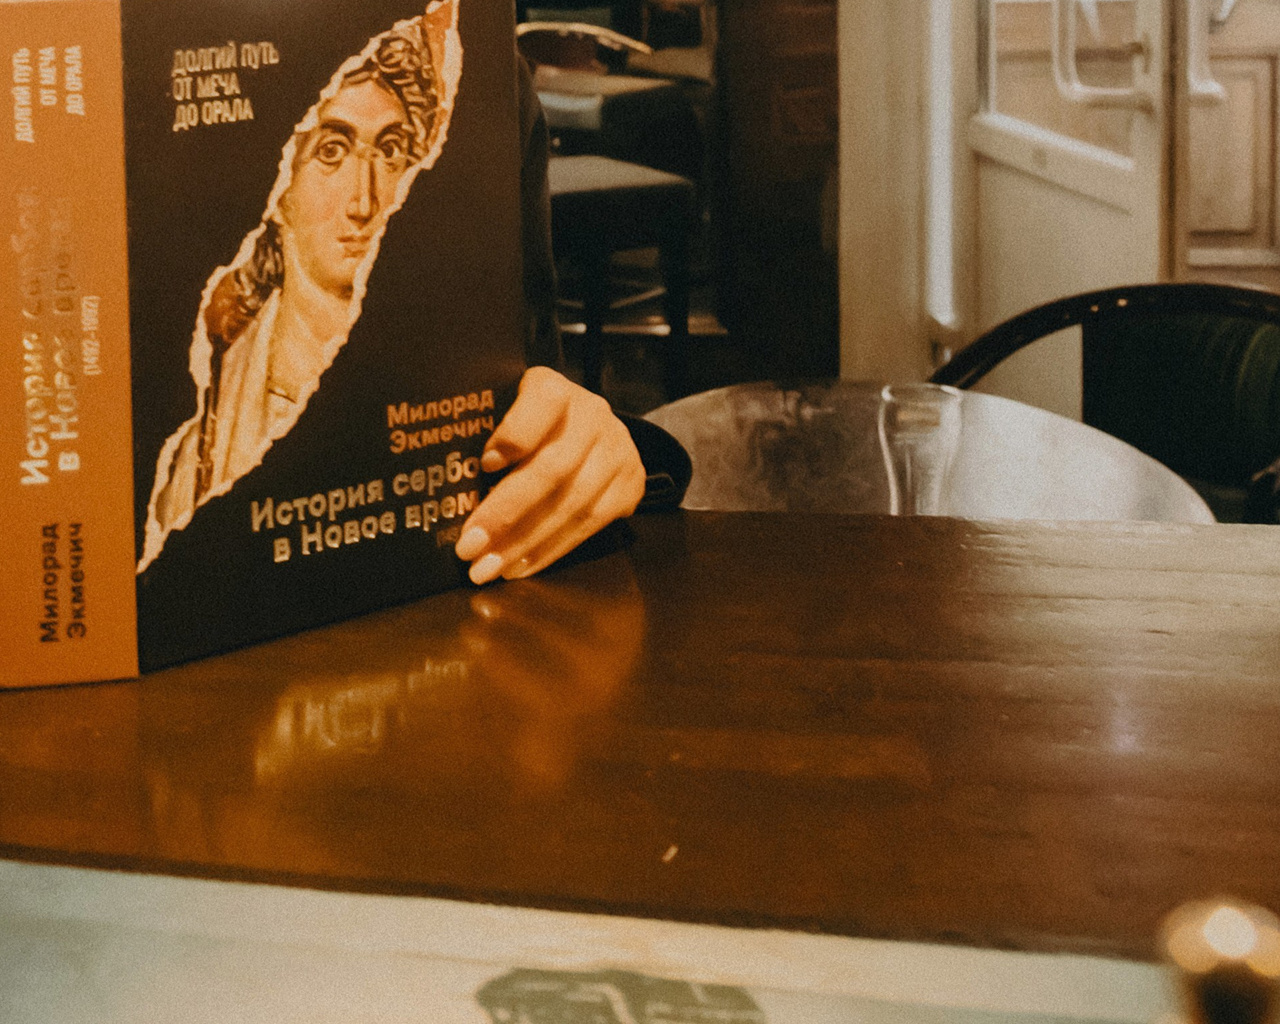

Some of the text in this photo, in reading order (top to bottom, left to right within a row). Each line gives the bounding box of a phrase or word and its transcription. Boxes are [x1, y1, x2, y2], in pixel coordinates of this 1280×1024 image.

[171, 40, 280, 77] ДОЛГИЙ ПУТЬ
[173, 72, 241, 101] ОТ МЕЧА
[172, 98, 254, 132] ДО ОРАЛА
[387, 389, 494, 428] Милорад
[389, 415, 495, 454] Экмечич
[57, 451, 81, 472] в
[251, 451, 480, 532] История сербо
[273, 537, 291, 563] в
[301, 511, 396, 555] Новое
[405, 490, 479, 532] врем
[40, 523, 61, 643] Милорад
[66, 523, 87, 638] Экмечич
